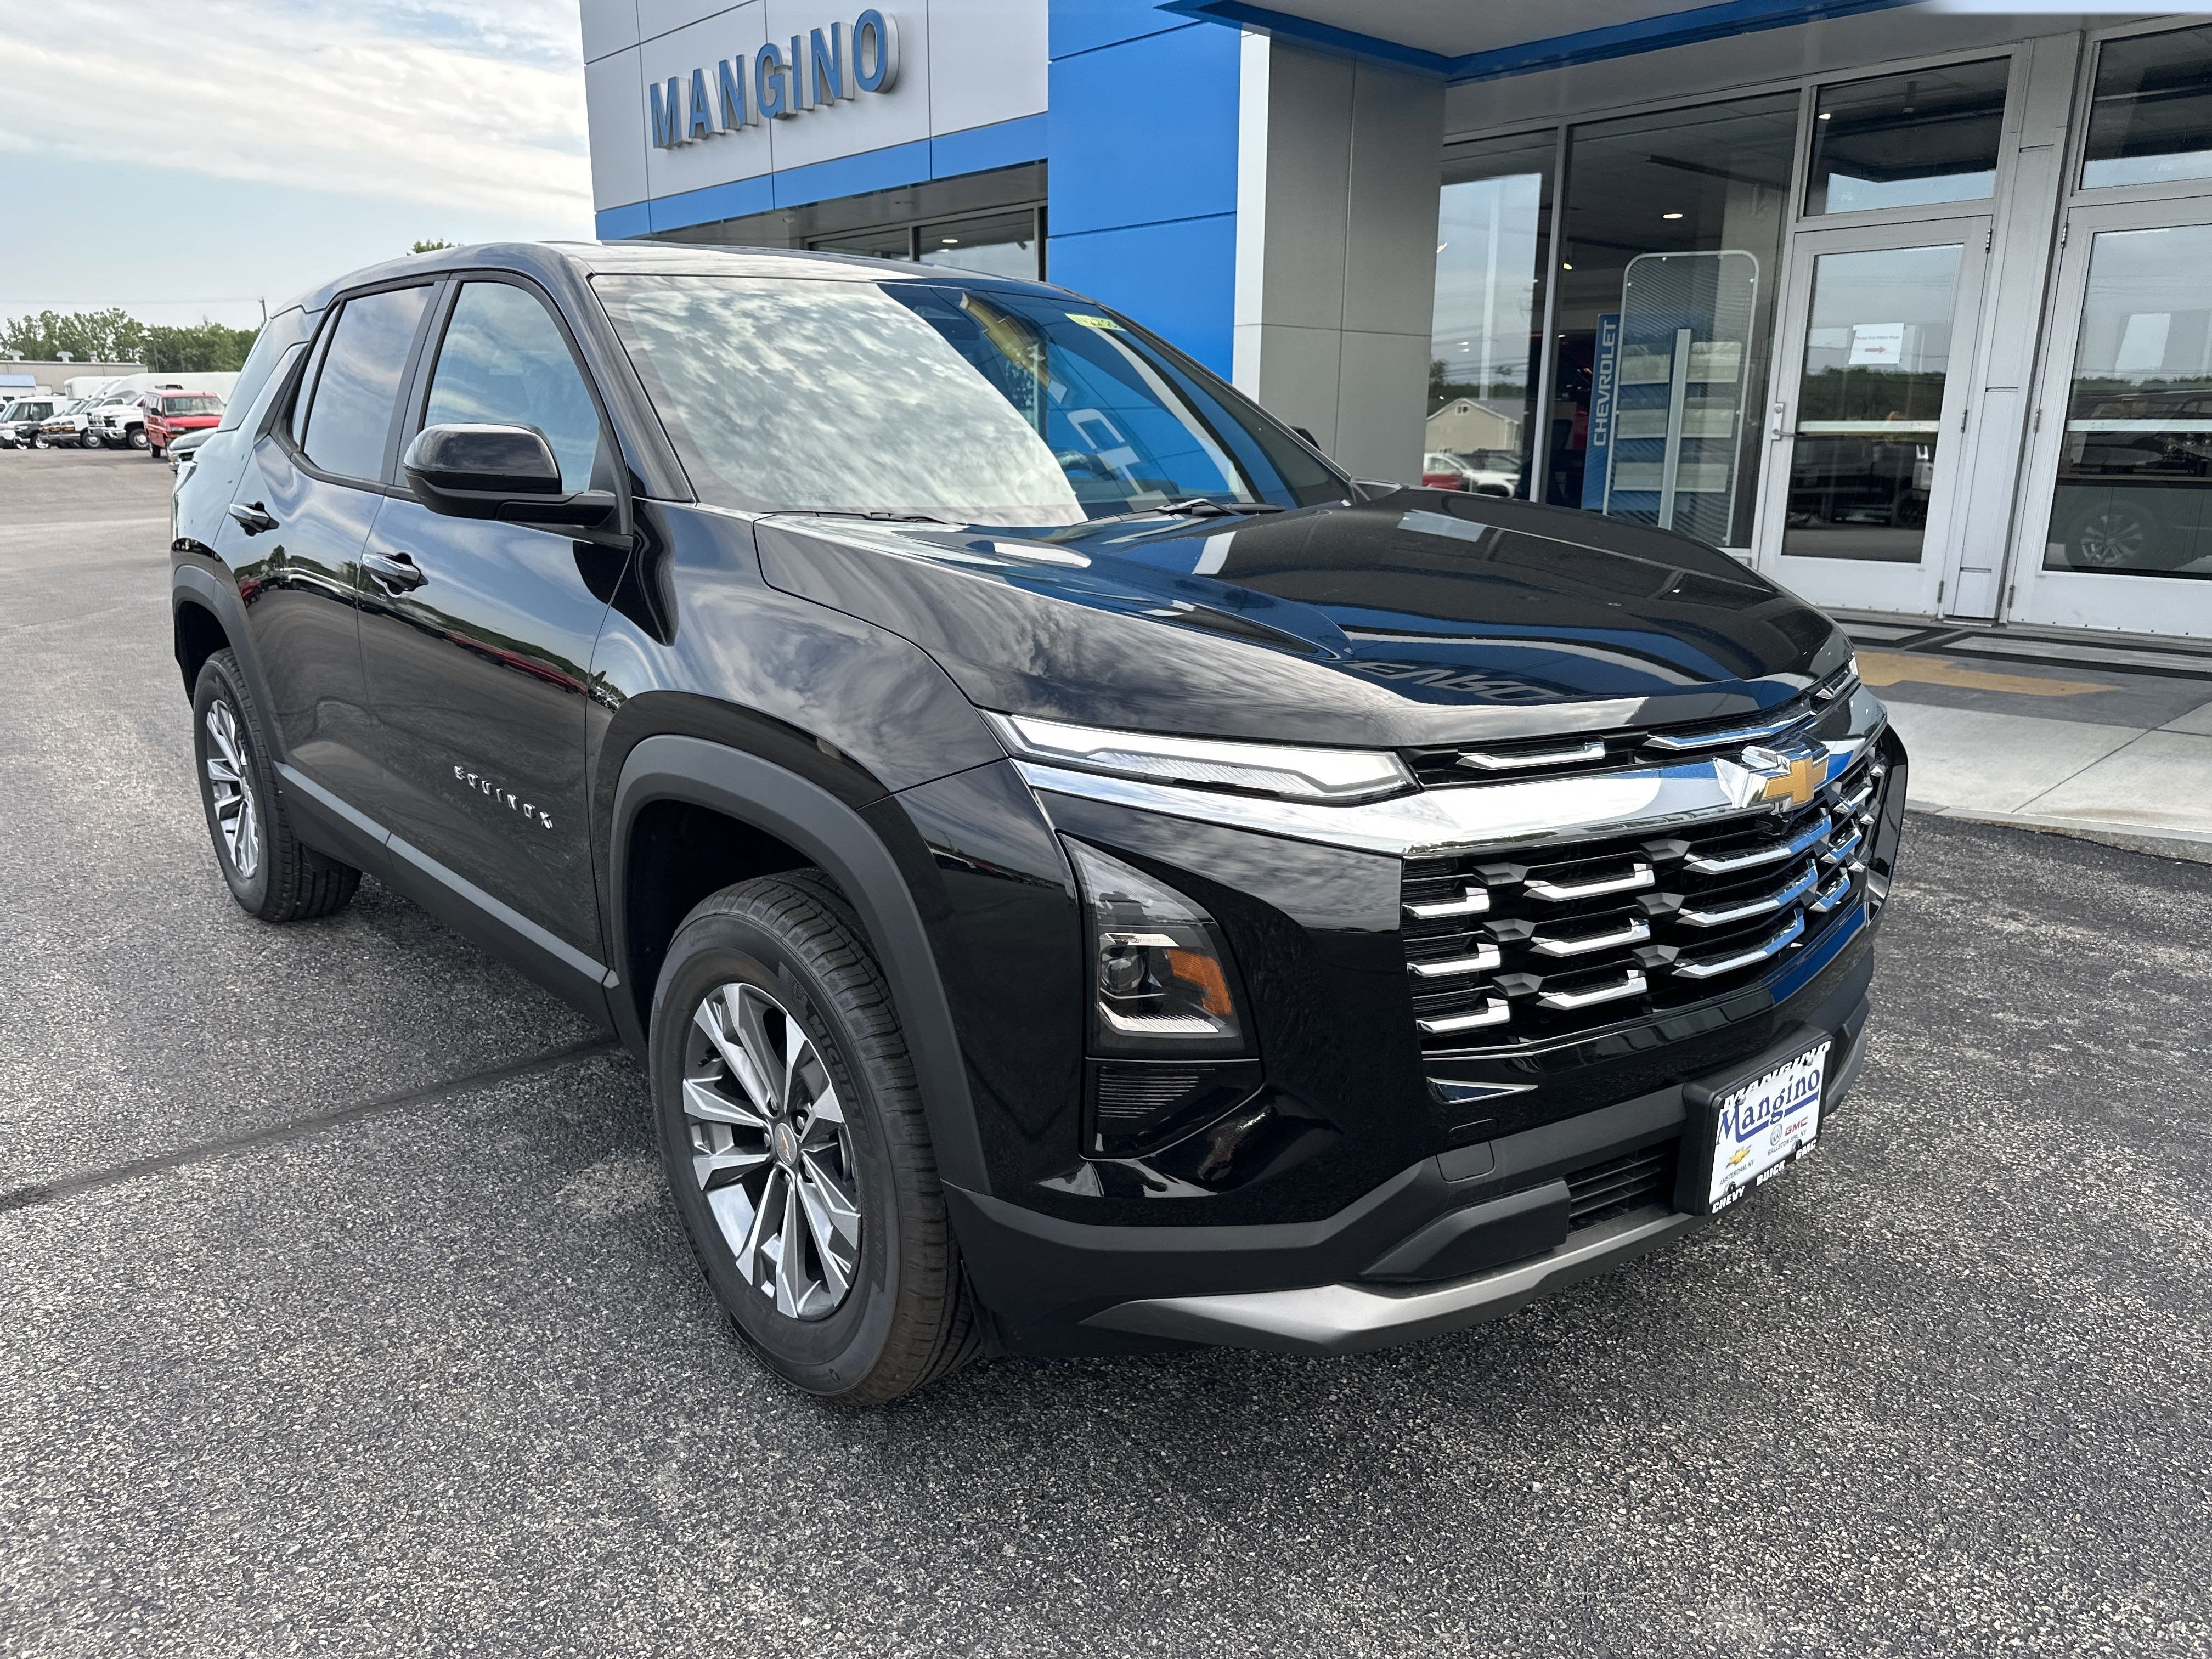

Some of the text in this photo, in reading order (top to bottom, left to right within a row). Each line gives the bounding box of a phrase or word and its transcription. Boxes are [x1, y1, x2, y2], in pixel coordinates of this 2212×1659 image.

[650, 9, 900, 149] MANGINO
[1593, 320, 1616, 447] CHEVROLET
[454, 765, 554, 830] EQUINOX
[1716, 1069, 1820, 1146] Mangino
[1768, 1139, 1790, 1156] BALLSTON
[1800, 1129, 1807, 1137] NY
[1785, 1116, 1808, 1136] GMC
[1712, 1139, 1817, 1214] CHEVY BUICK GMC
[1748, 1159, 1754, 1168] NY
